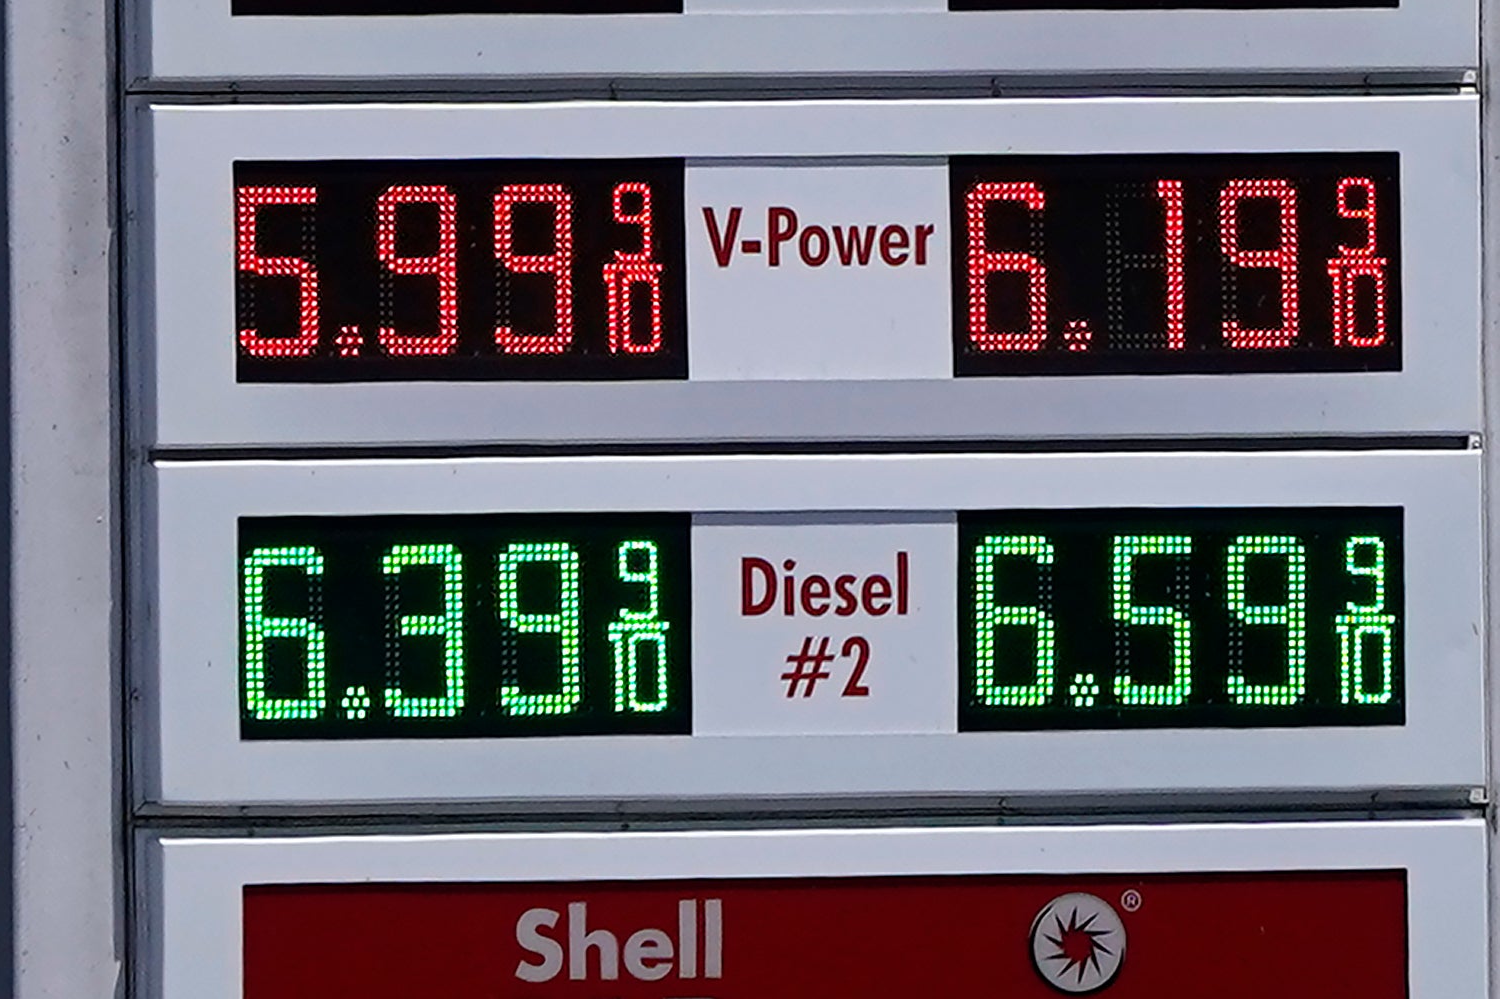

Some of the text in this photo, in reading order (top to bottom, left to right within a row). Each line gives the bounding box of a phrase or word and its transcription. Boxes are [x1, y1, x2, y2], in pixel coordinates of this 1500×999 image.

[237, 182, 574, 358] 5.99
[702, 206, 934, 268] V-Power
[965, 177, 1301, 352] 6.19
[243, 541, 581, 721] 6.39
[740, 551, 909, 617] Diesel
[974, 534, 1307, 708] 6.59
[780, 635, 870, 698] #2
[514, 897, 723, 983] Shell
